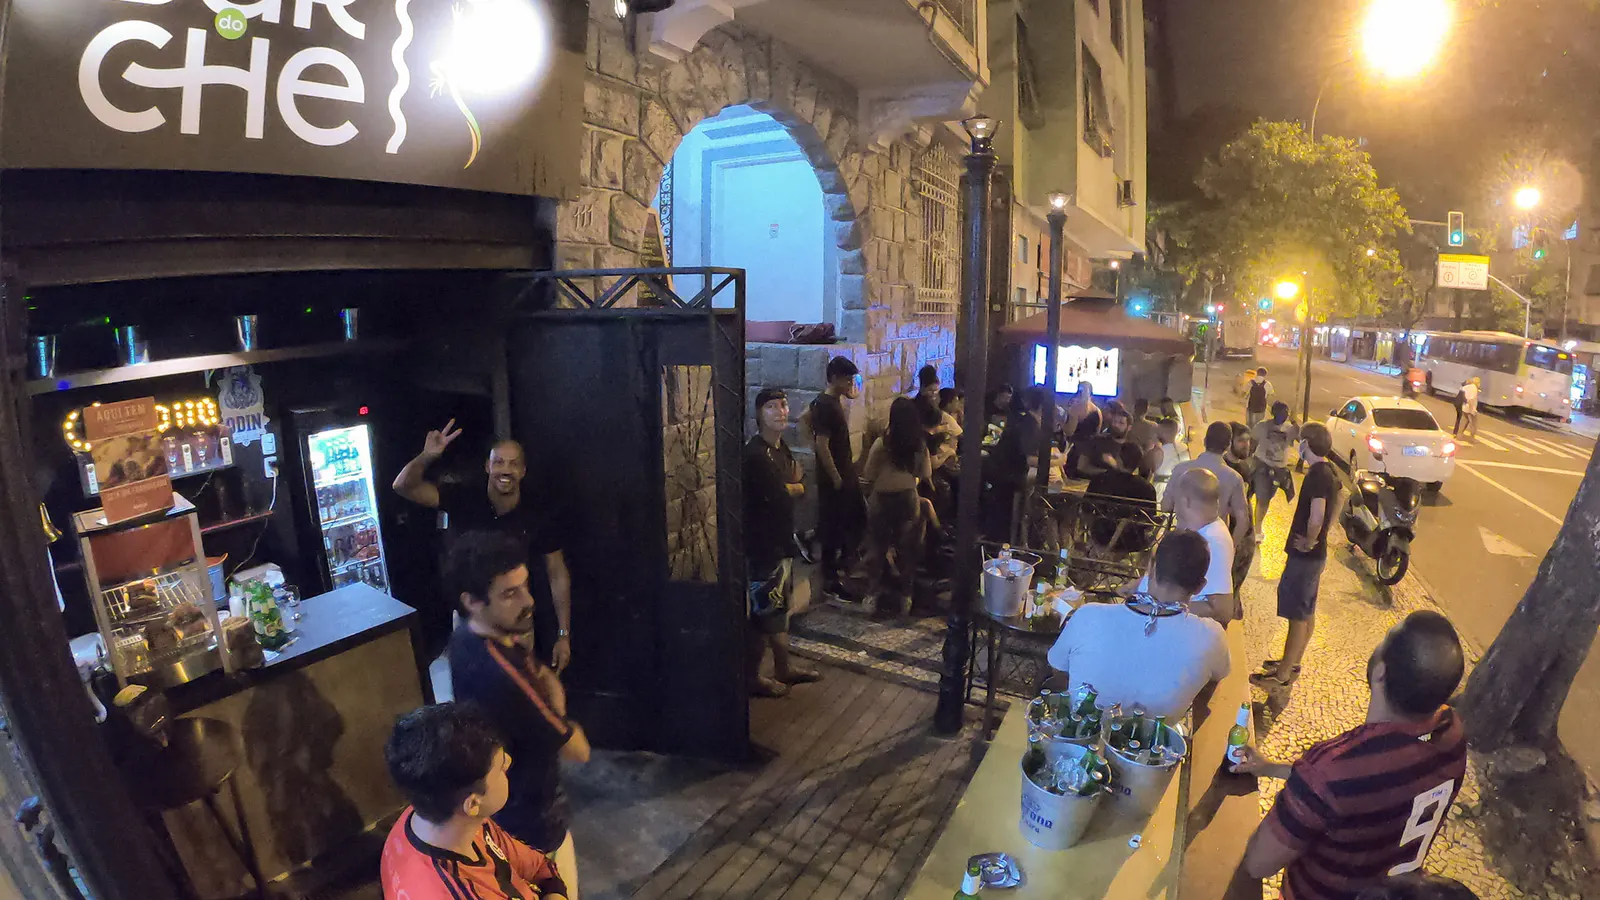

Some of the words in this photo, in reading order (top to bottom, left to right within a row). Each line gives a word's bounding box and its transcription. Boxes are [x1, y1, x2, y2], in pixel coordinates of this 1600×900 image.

[218, 14, 243, 32] do
[226, 413, 261, 433] ODIN
[1387, 779, 1454, 876] 9
